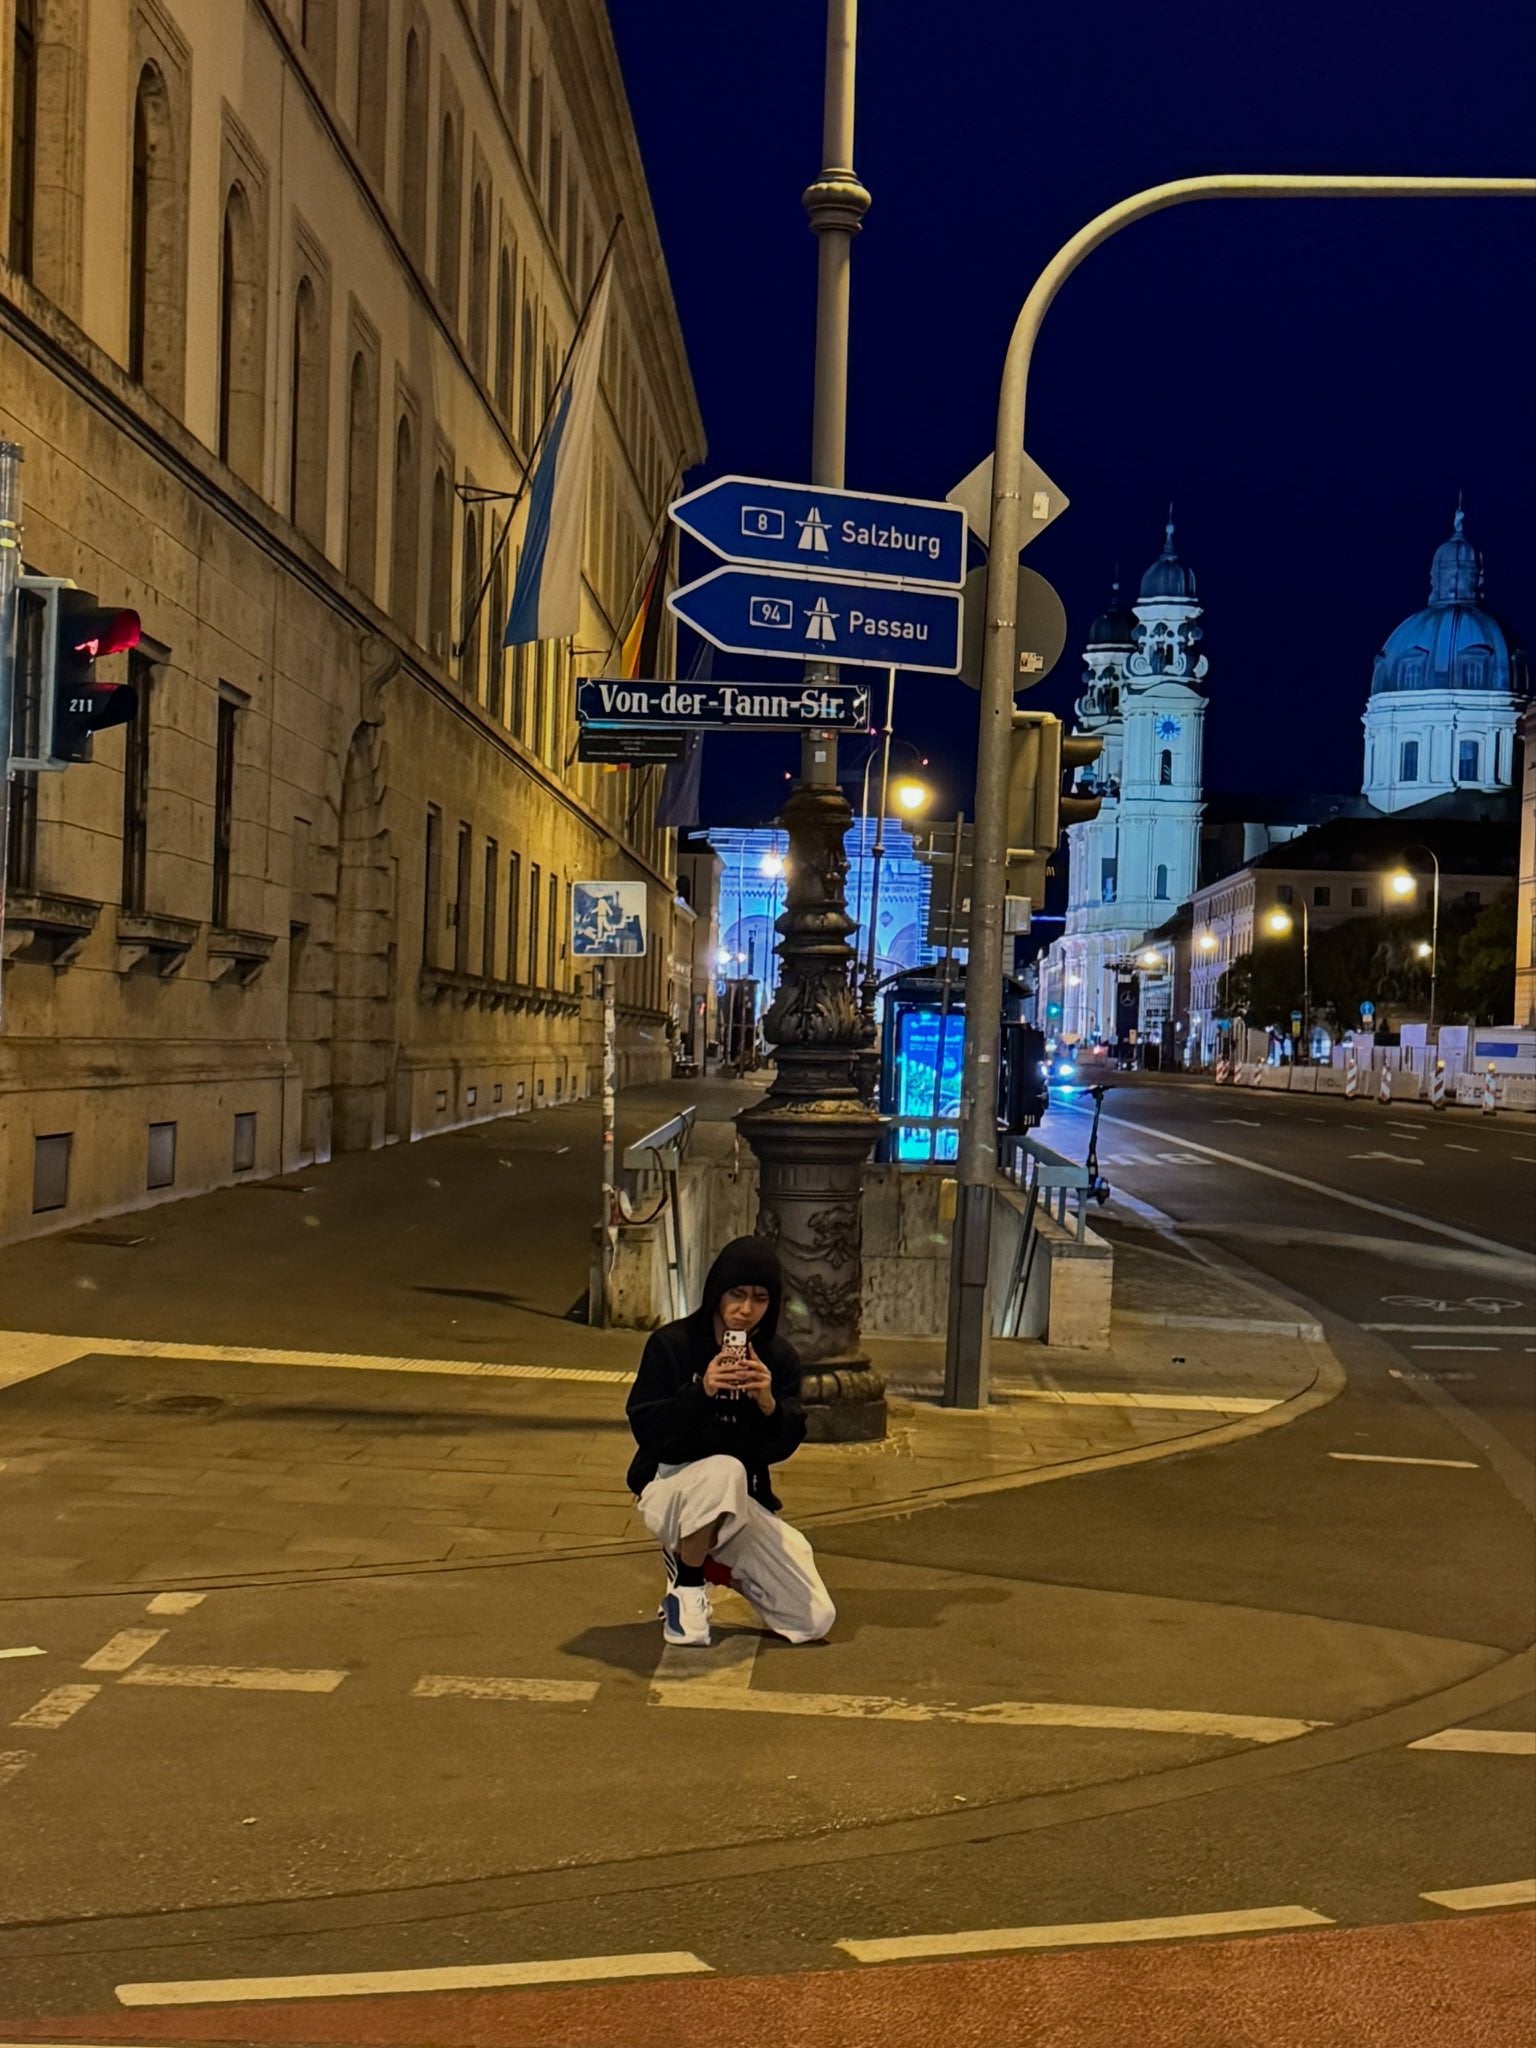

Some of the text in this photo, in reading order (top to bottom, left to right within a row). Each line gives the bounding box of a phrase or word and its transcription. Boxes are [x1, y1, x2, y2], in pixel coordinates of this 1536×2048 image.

[757, 513, 941, 560] 8 Salzburg
[761, 603, 928, 641] 94 Passau
[69, 698, 93, 713] 211
[599, 683, 846, 719] Von-der-Tann-Str.
